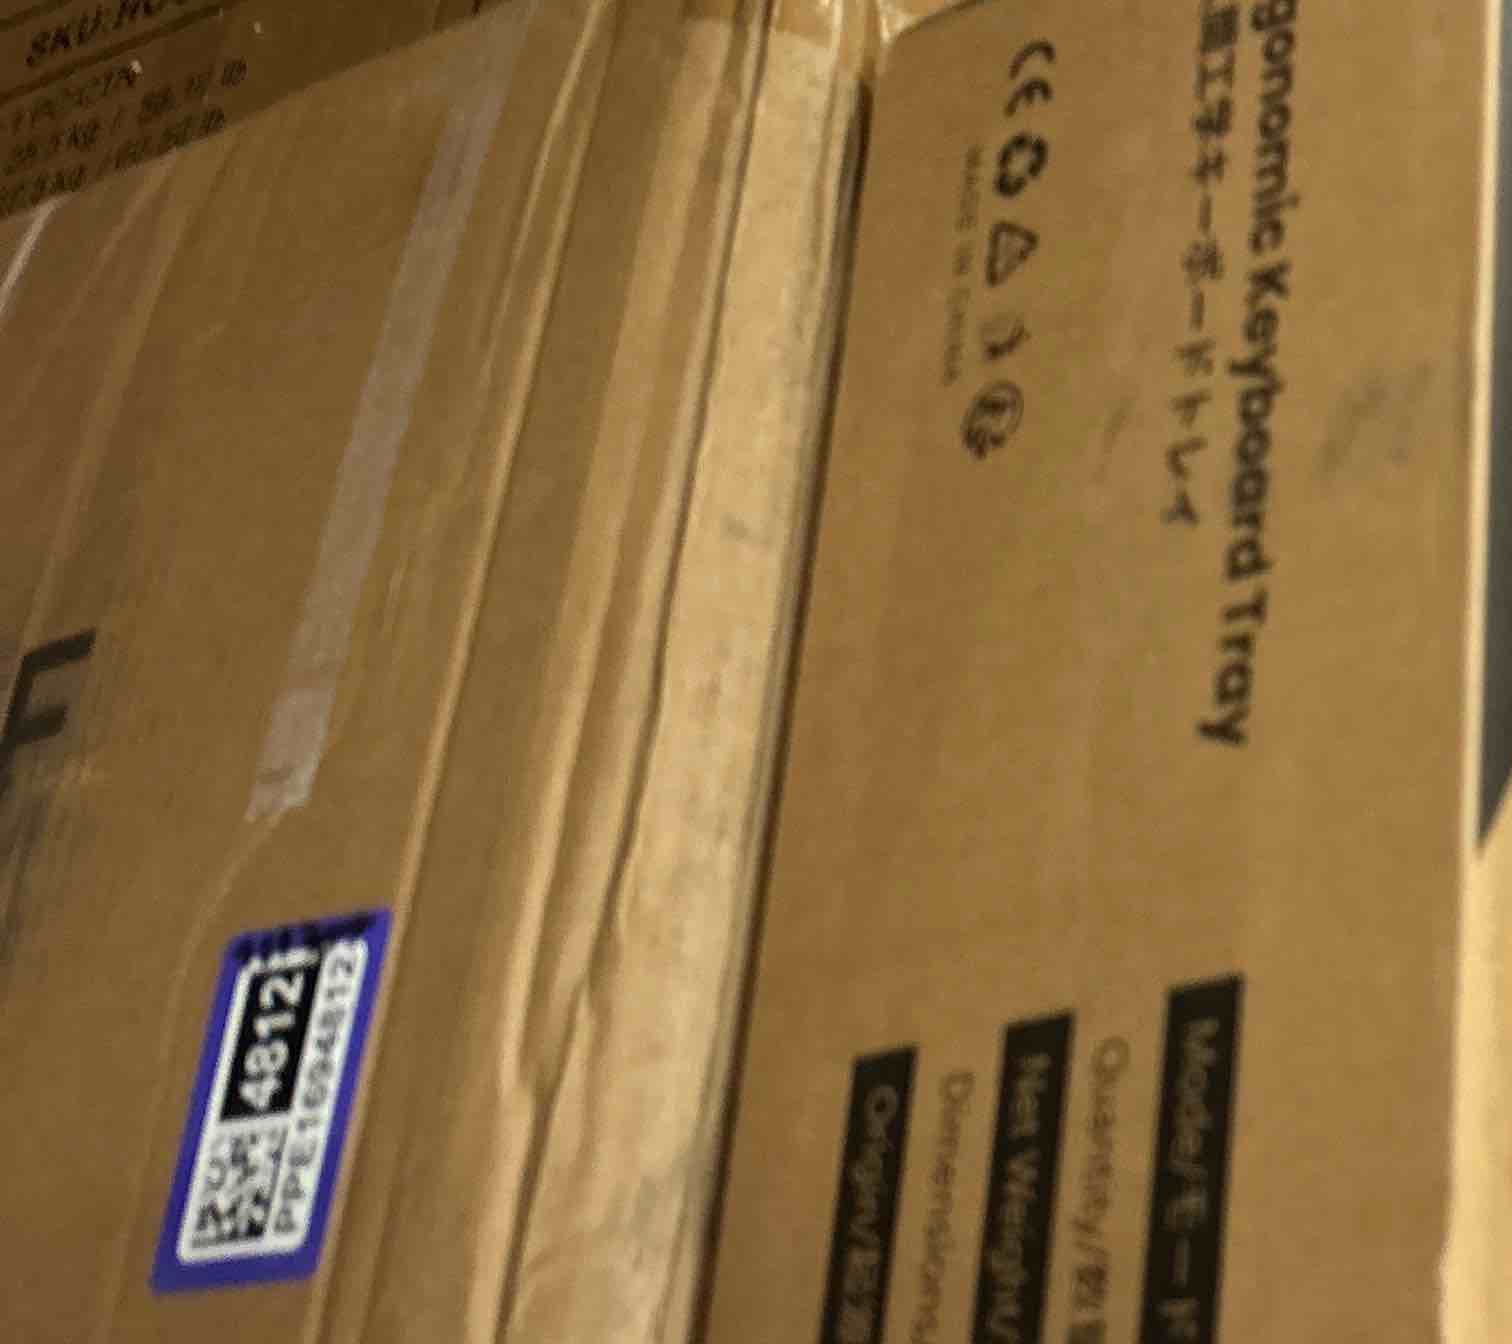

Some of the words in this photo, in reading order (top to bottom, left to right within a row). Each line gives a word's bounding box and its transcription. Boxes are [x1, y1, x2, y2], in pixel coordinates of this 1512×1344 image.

[1226, 259, 1292, 582] Keyboard
[1196, 588, 1269, 748] Tray
[240, 974, 304, 1110] 4812
[1006, 1052, 1050, 1139] Net
